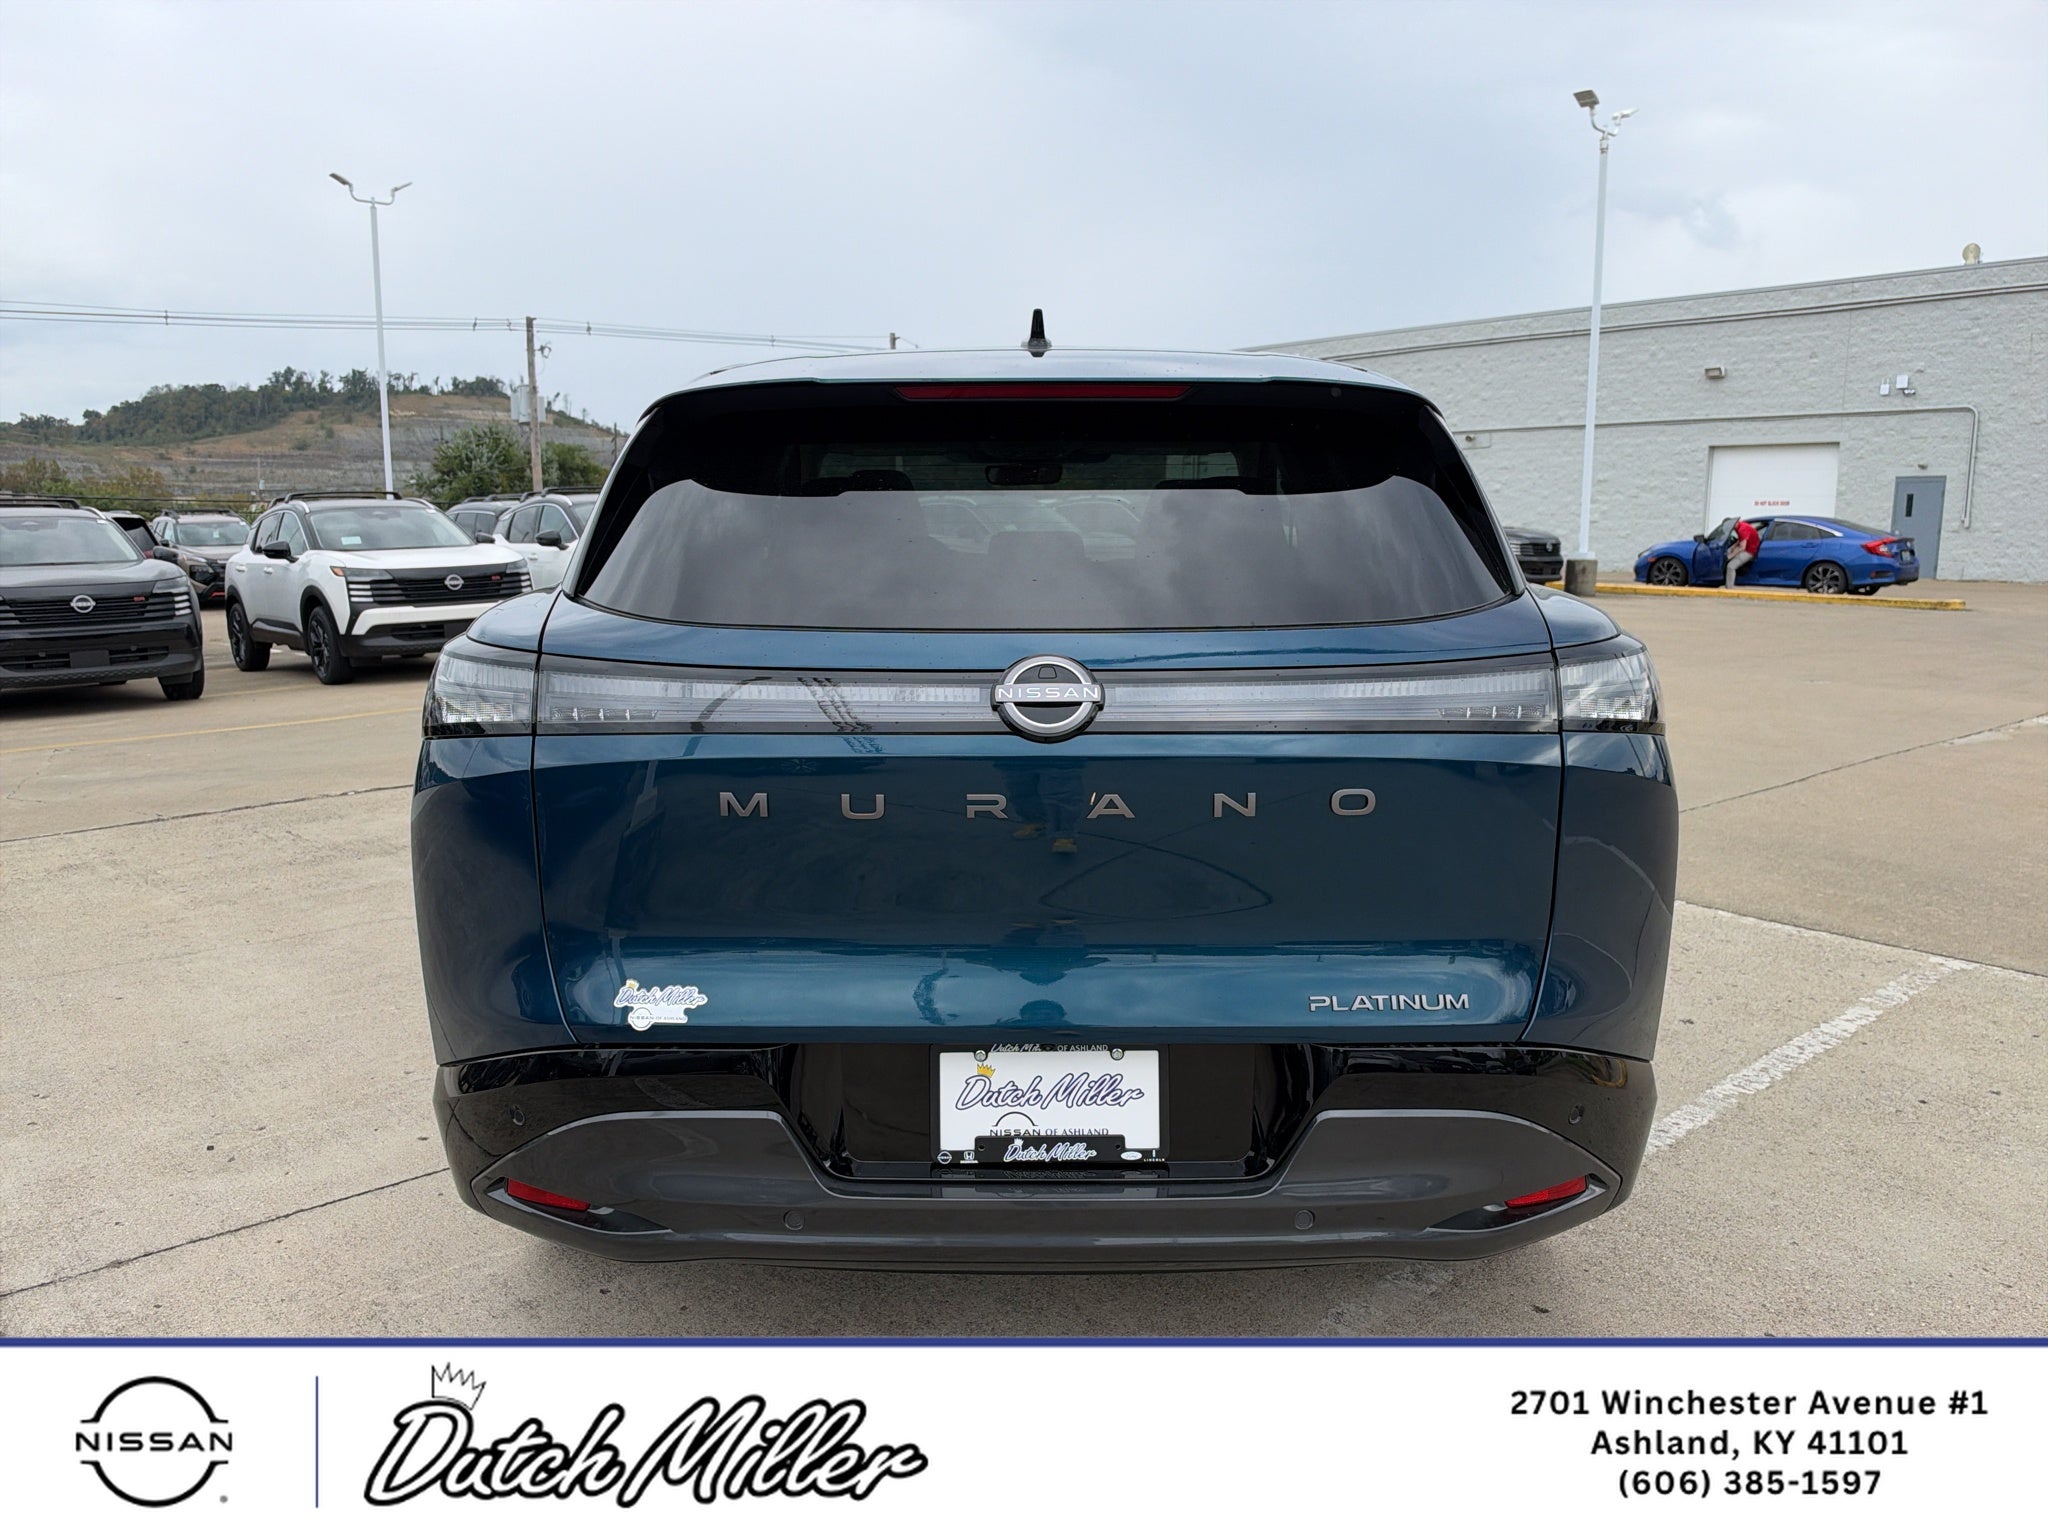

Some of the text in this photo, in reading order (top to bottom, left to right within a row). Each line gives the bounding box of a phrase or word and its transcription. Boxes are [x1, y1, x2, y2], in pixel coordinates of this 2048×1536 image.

[998, 687, 1098, 699] NISSAN
[719, 788, 1377, 820] MURANO
[615, 985, 706, 1007] Dutch Miller
[1308, 993, 1470, 1012] PLATINUM
[955, 1072, 1145, 1111] Dutch Miller
[989, 1128, 1109, 1136] NISSAN OF ASHLAND
[1003, 1142, 1098, 1162] Dutch Miller
